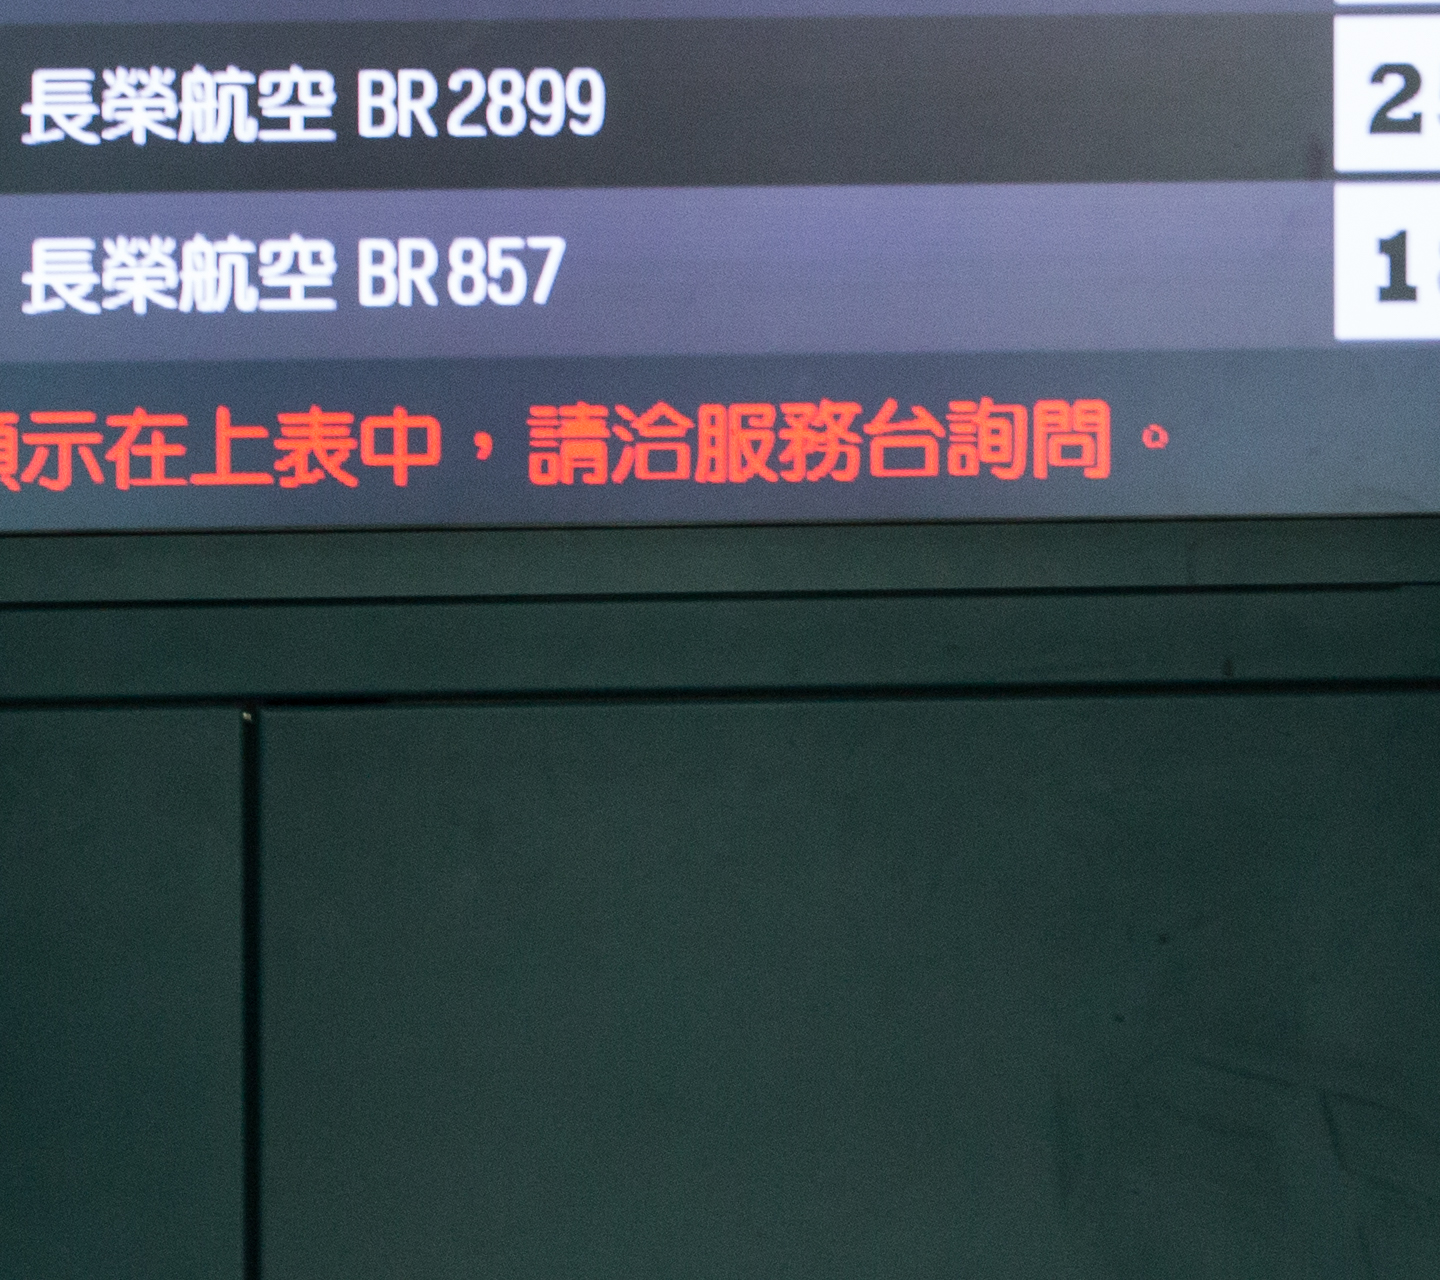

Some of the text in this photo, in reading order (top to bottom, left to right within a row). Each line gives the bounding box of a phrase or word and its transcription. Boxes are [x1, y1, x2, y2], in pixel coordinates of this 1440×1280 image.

[20, 64, 337, 146] 長榮航空
[20, 232, 338, 316] 長榮航空
